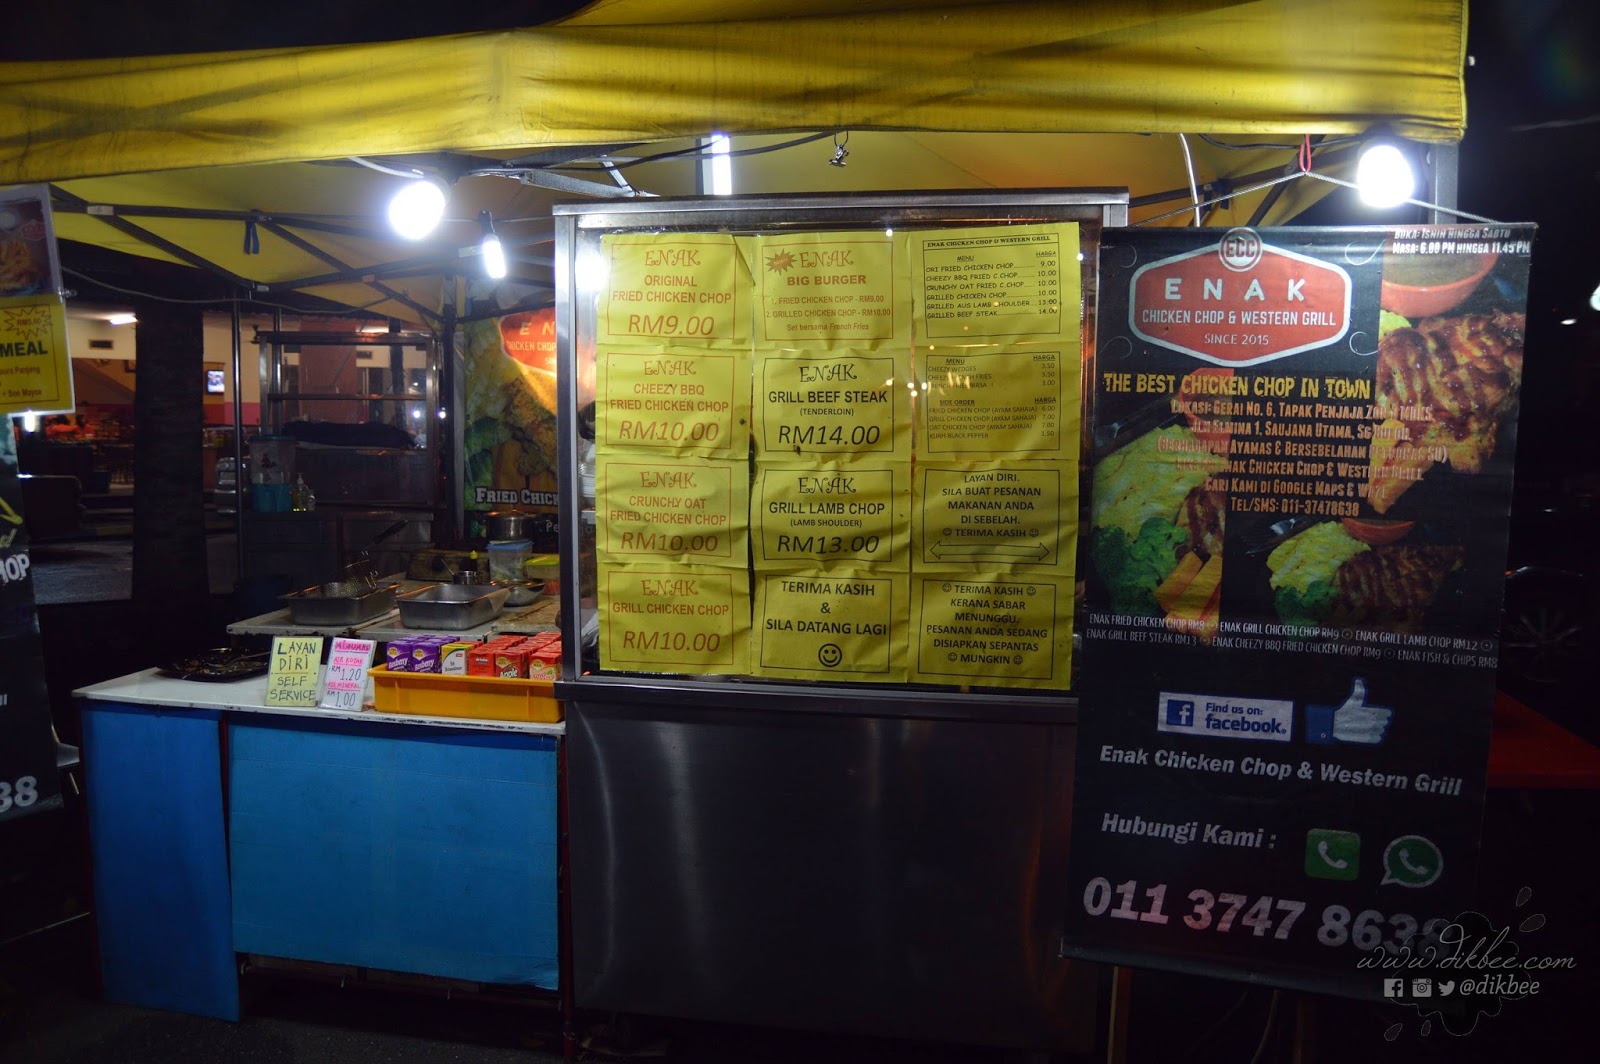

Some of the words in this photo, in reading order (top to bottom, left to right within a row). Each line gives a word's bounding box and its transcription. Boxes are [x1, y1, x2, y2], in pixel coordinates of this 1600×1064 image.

[1226, 240, 1255, 257] ECC
[1442, 242, 1454, 253] PM
[1517, 241, 1530, 253] PM
[645, 250, 701, 266] ENAK
[800, 250, 853, 268] ENAK
[644, 276, 697, 287] ORIGINAL
[787, 276, 811, 285] BIG
[815, 275, 866, 285] BURGER
[613, 291, 643, 301] FRIED
[646, 292, 696, 303] CHICKEN
[700, 293, 731, 303] CHOP
[801, 309, 836, 317] CHICKEN
[1142, 310, 1190, 323] CHICKEN
[1195, 311, 1224, 324] CHOP
[1229, 312, 1236, 324] &
[1241, 311, 1298, 325] WESTERN
[1303, 312, 1336, 326] GRILL
[628, 314, 714, 335] RM9.00
[1204, 334, 1237, 344] SINCE
[1242, 335, 1269, 345] 2015
[0, 340, 48, 356] MEAL
[537, 342, 556, 351] CHOP
[644, 360, 696, 375] ENAK
[799, 364, 857, 382] ENAK
[634, 384, 675, 394] CHEEZY
[680, 384, 704, 396] BBQ
[1104, 373, 1131, 392] THE
[1136, 373, 1175, 393] BEST
[1181, 375, 1248, 397] CHICKEN
[1254, 376, 1295, 398] CHOP
[1302, 377, 1318, 396] IN
[1325, 377, 1370, 399] TOWN
[769, 392, 804, 403] GRILL
[808, 392, 840, 403] BEEF
[844, 391, 887, 403] STEAK
[611, 400, 642, 410] FRIED
[645, 400, 694, 411] CHICKEN
[697, 401, 729, 412] CHOP
[800, 408, 854, 416] (TENDERLOIN)
[619, 421, 718, 441] RM10.00
[778, 425, 879, 444] RM14.00
[640, 472, 696, 488] ENAK
[965, 474, 993, 483] LAYAN
[798, 477, 856, 494] ENAK
[942, 488, 962, 496] SILA
[965, 487, 991, 496] BUAT
[994, 488, 1041, 496] PESANAN
[1231, 478, 1257, 492] KAMI
[1261, 481, 1270, 492] DI
[1274, 479, 1312, 495] GOOGLE
[1315, 481, 1344, 496] MAPS
[1347, 482, 1354, 497] &
[476, 488, 518, 503] FRIED
[629, 496, 681, 508] CRUNCHY
[684, 498, 706, 509] OAT
[769, 502, 806, 514] GRILL
[810, 502, 844, 514] LAMB
[849, 503, 884, 515] CHOP
[948, 501, 1001, 510] MAKANAN
[1005, 502, 1034, 510] ANDA
[1282, 499, 1359, 516] 011-37478638
[610, 510, 641, 521] FRIED
[644, 512, 693, 525] CHICKEN
[696, 514, 726, 525] CHOP
[791, 519, 816, 527] (LAMB
[817, 519, 862, 528] SHOULDER)
[974, 516, 1020, 524] SEBELAH.
[997, 529, 1026, 537] KASIH
[621, 532, 718, 551] RM10.00
[778, 535, 879, 554] RM13.00
[641, 580, 698, 596] ENAK
[782, 581, 831, 594] TERIMA
[835, 583, 874, 595] KASIH
[955, 585, 991, 594] TERIMA
[994, 586, 1023, 595] KASIH
[613, 603, 644, 613] GRILL
[647, 604, 694, 615] CHICKEN
[697, 605, 729, 616] CHOP
[820, 602, 831, 613] &
[951, 599, 990, 608] KERANA
[993, 601, 1025, 610] SABAR
[955, 613, 1019, 623] MENUNGGU.
[1090, 614, 1110, 624] ENAK
[1112, 615, 1132, 625] FRIED
[1133, 616, 1164, 628] CHICKEN
[766, 619, 793, 631] SILA
[797, 621, 851, 634] DATANG
[856, 624, 886, 635] LAGI
[927, 625, 972, 634] PESANAN
[975, 628, 1003, 636] ANDA
[1007, 629, 1047, 638] SEDANG
[623, 631, 720, 651] RM10.00
[934, 639, 986, 649] DISIAPKAN
[990, 642, 1038, 651] SEPANTAS
[278, 642, 316, 654] LAYAN
[961, 654, 1010, 664] MUNGKIN
[341, 669, 361, 680] 1.20
[278, 676, 307, 687] SELF
[270, 690, 316, 701] SERVICE
[335, 692, 355, 707] 1.00
[1206, 703, 1229, 713] Find
[1232, 706, 1243, 714] us
[1247, 706, 1263, 715] on:
[1100, 745, 1148, 766] Enak
[1154, 748, 1234, 773] Chicken
[1240, 757, 1292, 780] Chop
[1297, 761, 1313, 780] &
[1320, 763, 1408, 790] Western
[1415, 773, 1462, 796] Grill
[1101, 813, 1198, 844] Hubungi
[1083, 877, 1168, 925] 011
[1183, 889, 1306, 940] 3747
[1317, 904, 1454, 958] 8638
